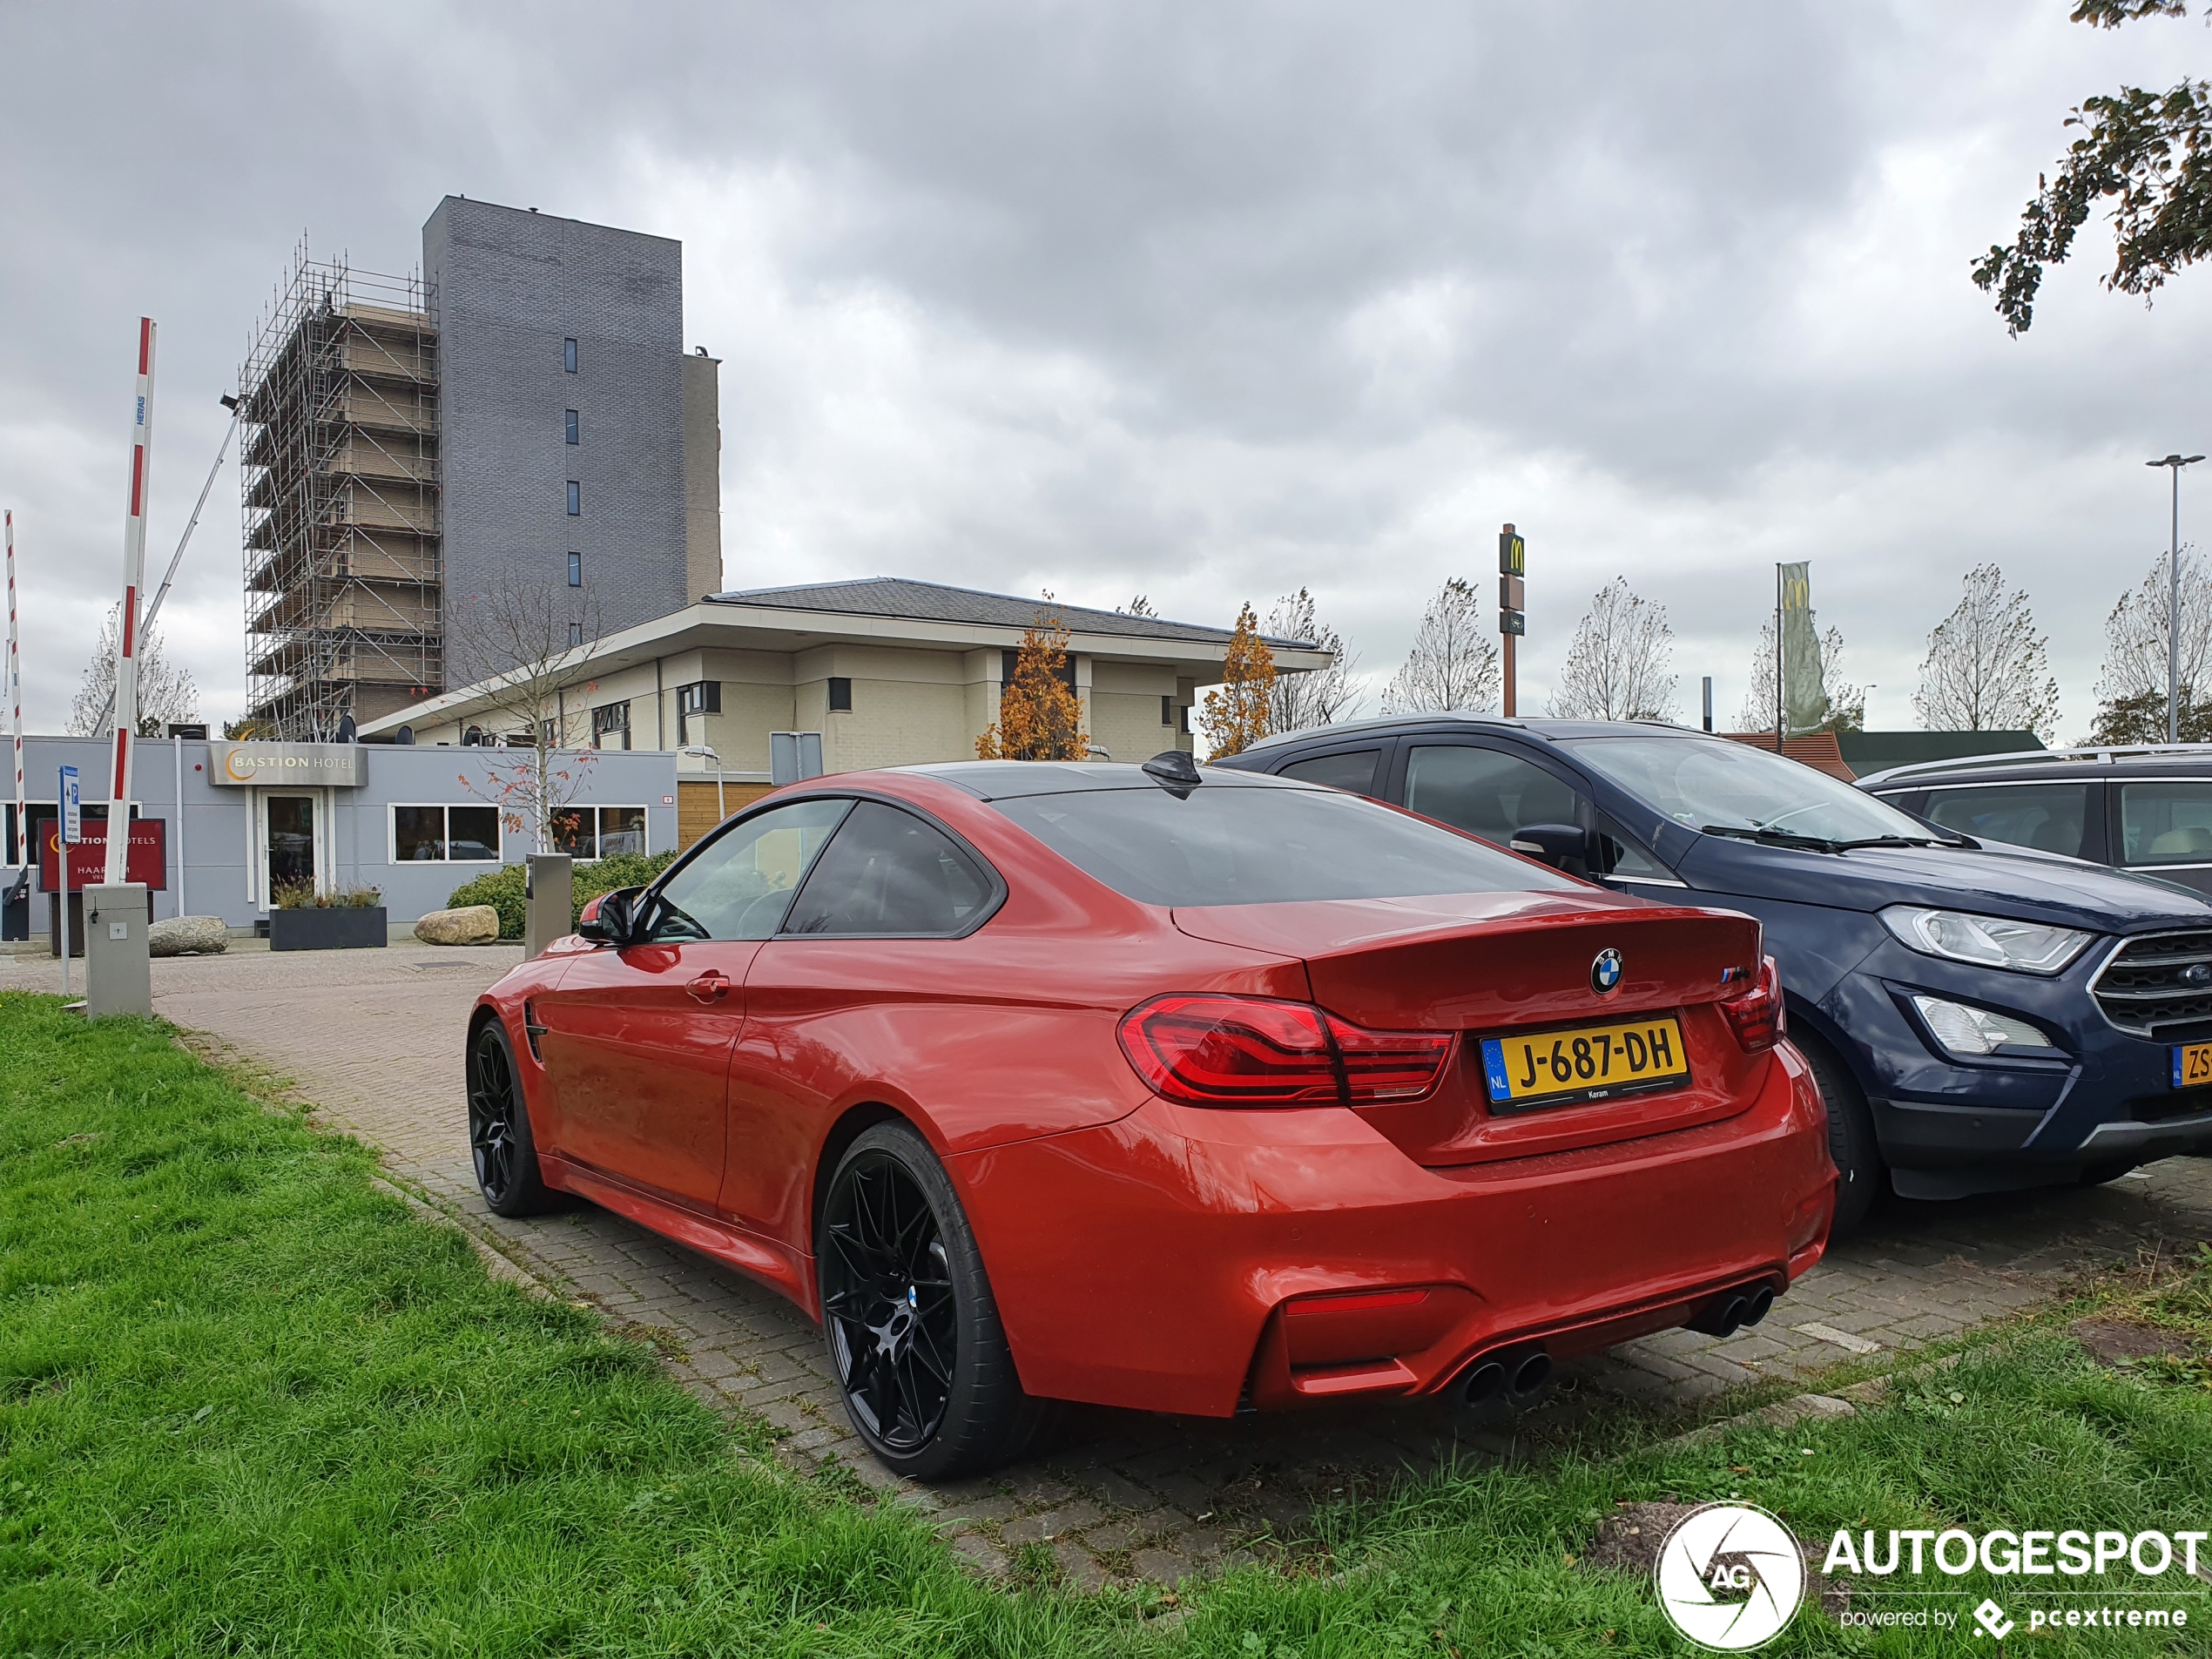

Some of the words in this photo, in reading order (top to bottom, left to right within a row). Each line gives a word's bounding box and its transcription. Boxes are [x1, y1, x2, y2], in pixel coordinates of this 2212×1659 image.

[234, 757, 309, 768] BASTION
[314, 758, 354, 769] HOTEL
[1491, 1076, 1507, 1089] NL
[1521, 1028, 1674, 1088] J-687-DH
[2174, 1070, 2181, 1079] NL
[2188, 1048, 2212, 1079] ZS
[1588, 1089, 1608, 1099] Keram
